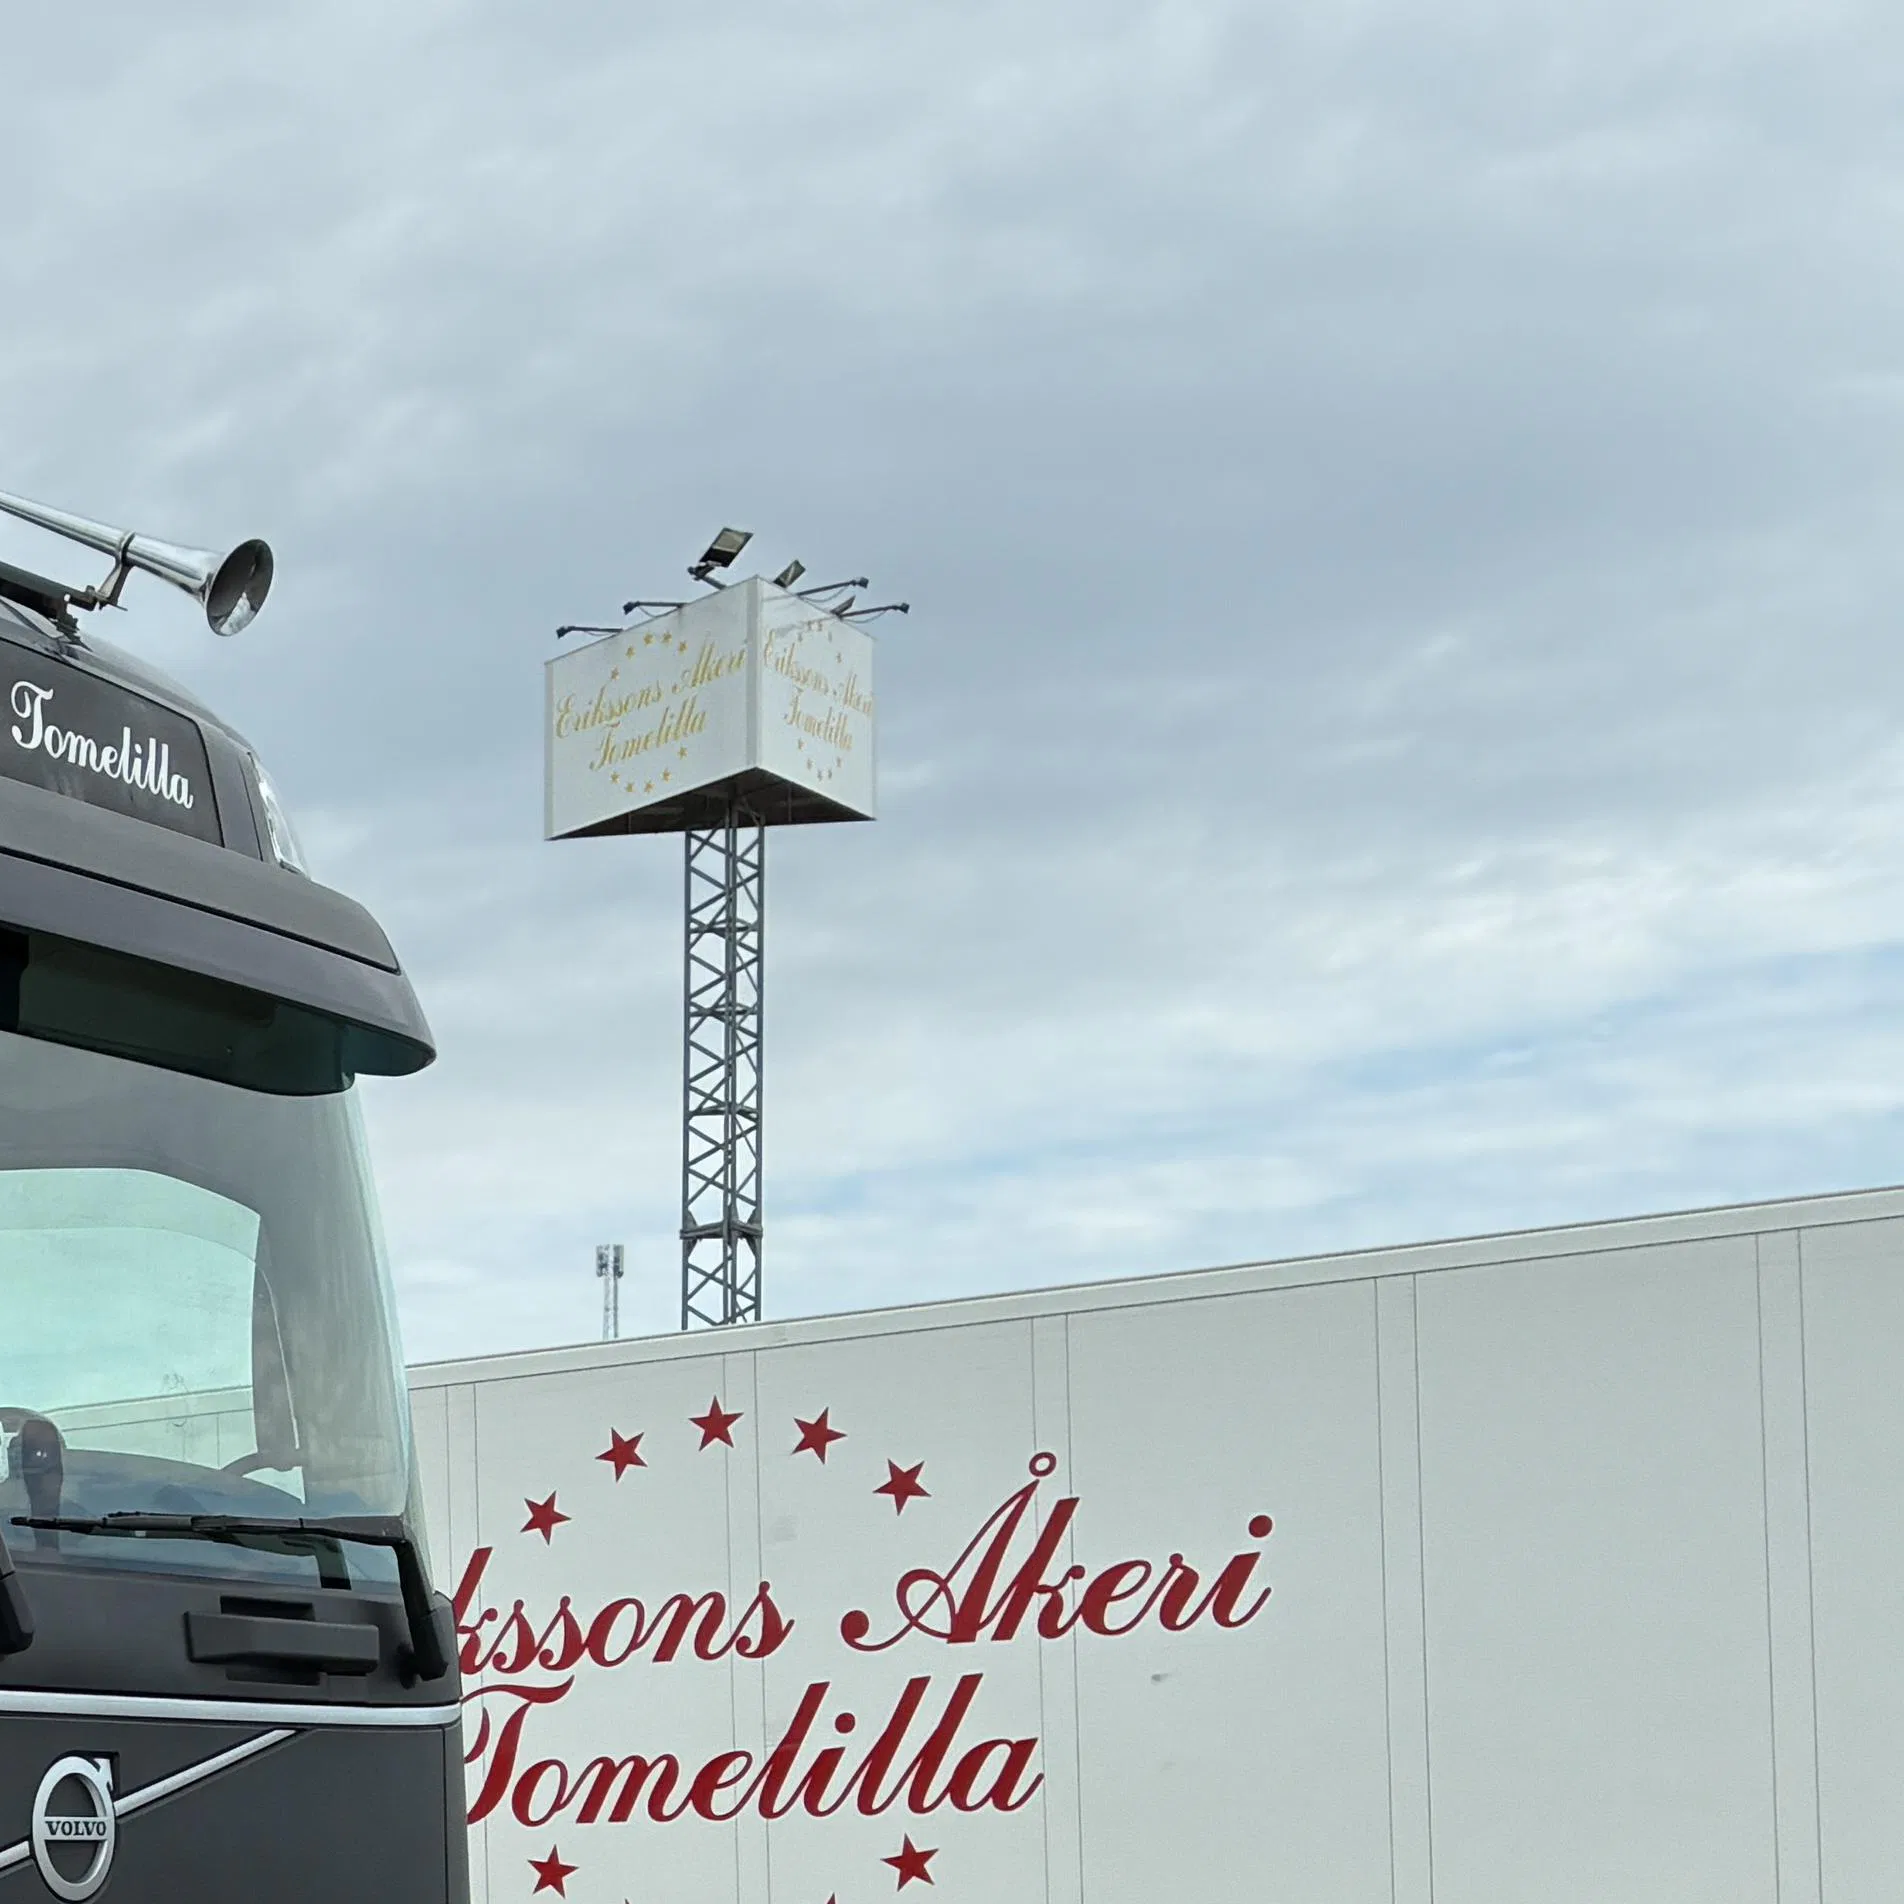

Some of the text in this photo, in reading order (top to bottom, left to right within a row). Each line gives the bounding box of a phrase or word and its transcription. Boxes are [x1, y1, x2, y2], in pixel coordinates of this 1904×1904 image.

[11, 680, 194, 810] Tomelilla
[556, 680, 665, 739] Erikssons
[589, 694, 706, 771] Tomelilla
[454, 1450, 1274, 1676] kssons Åkeri
[460, 1673, 1045, 1827] Tomelilla
[44, 1820, 107, 1837] VOLVO
